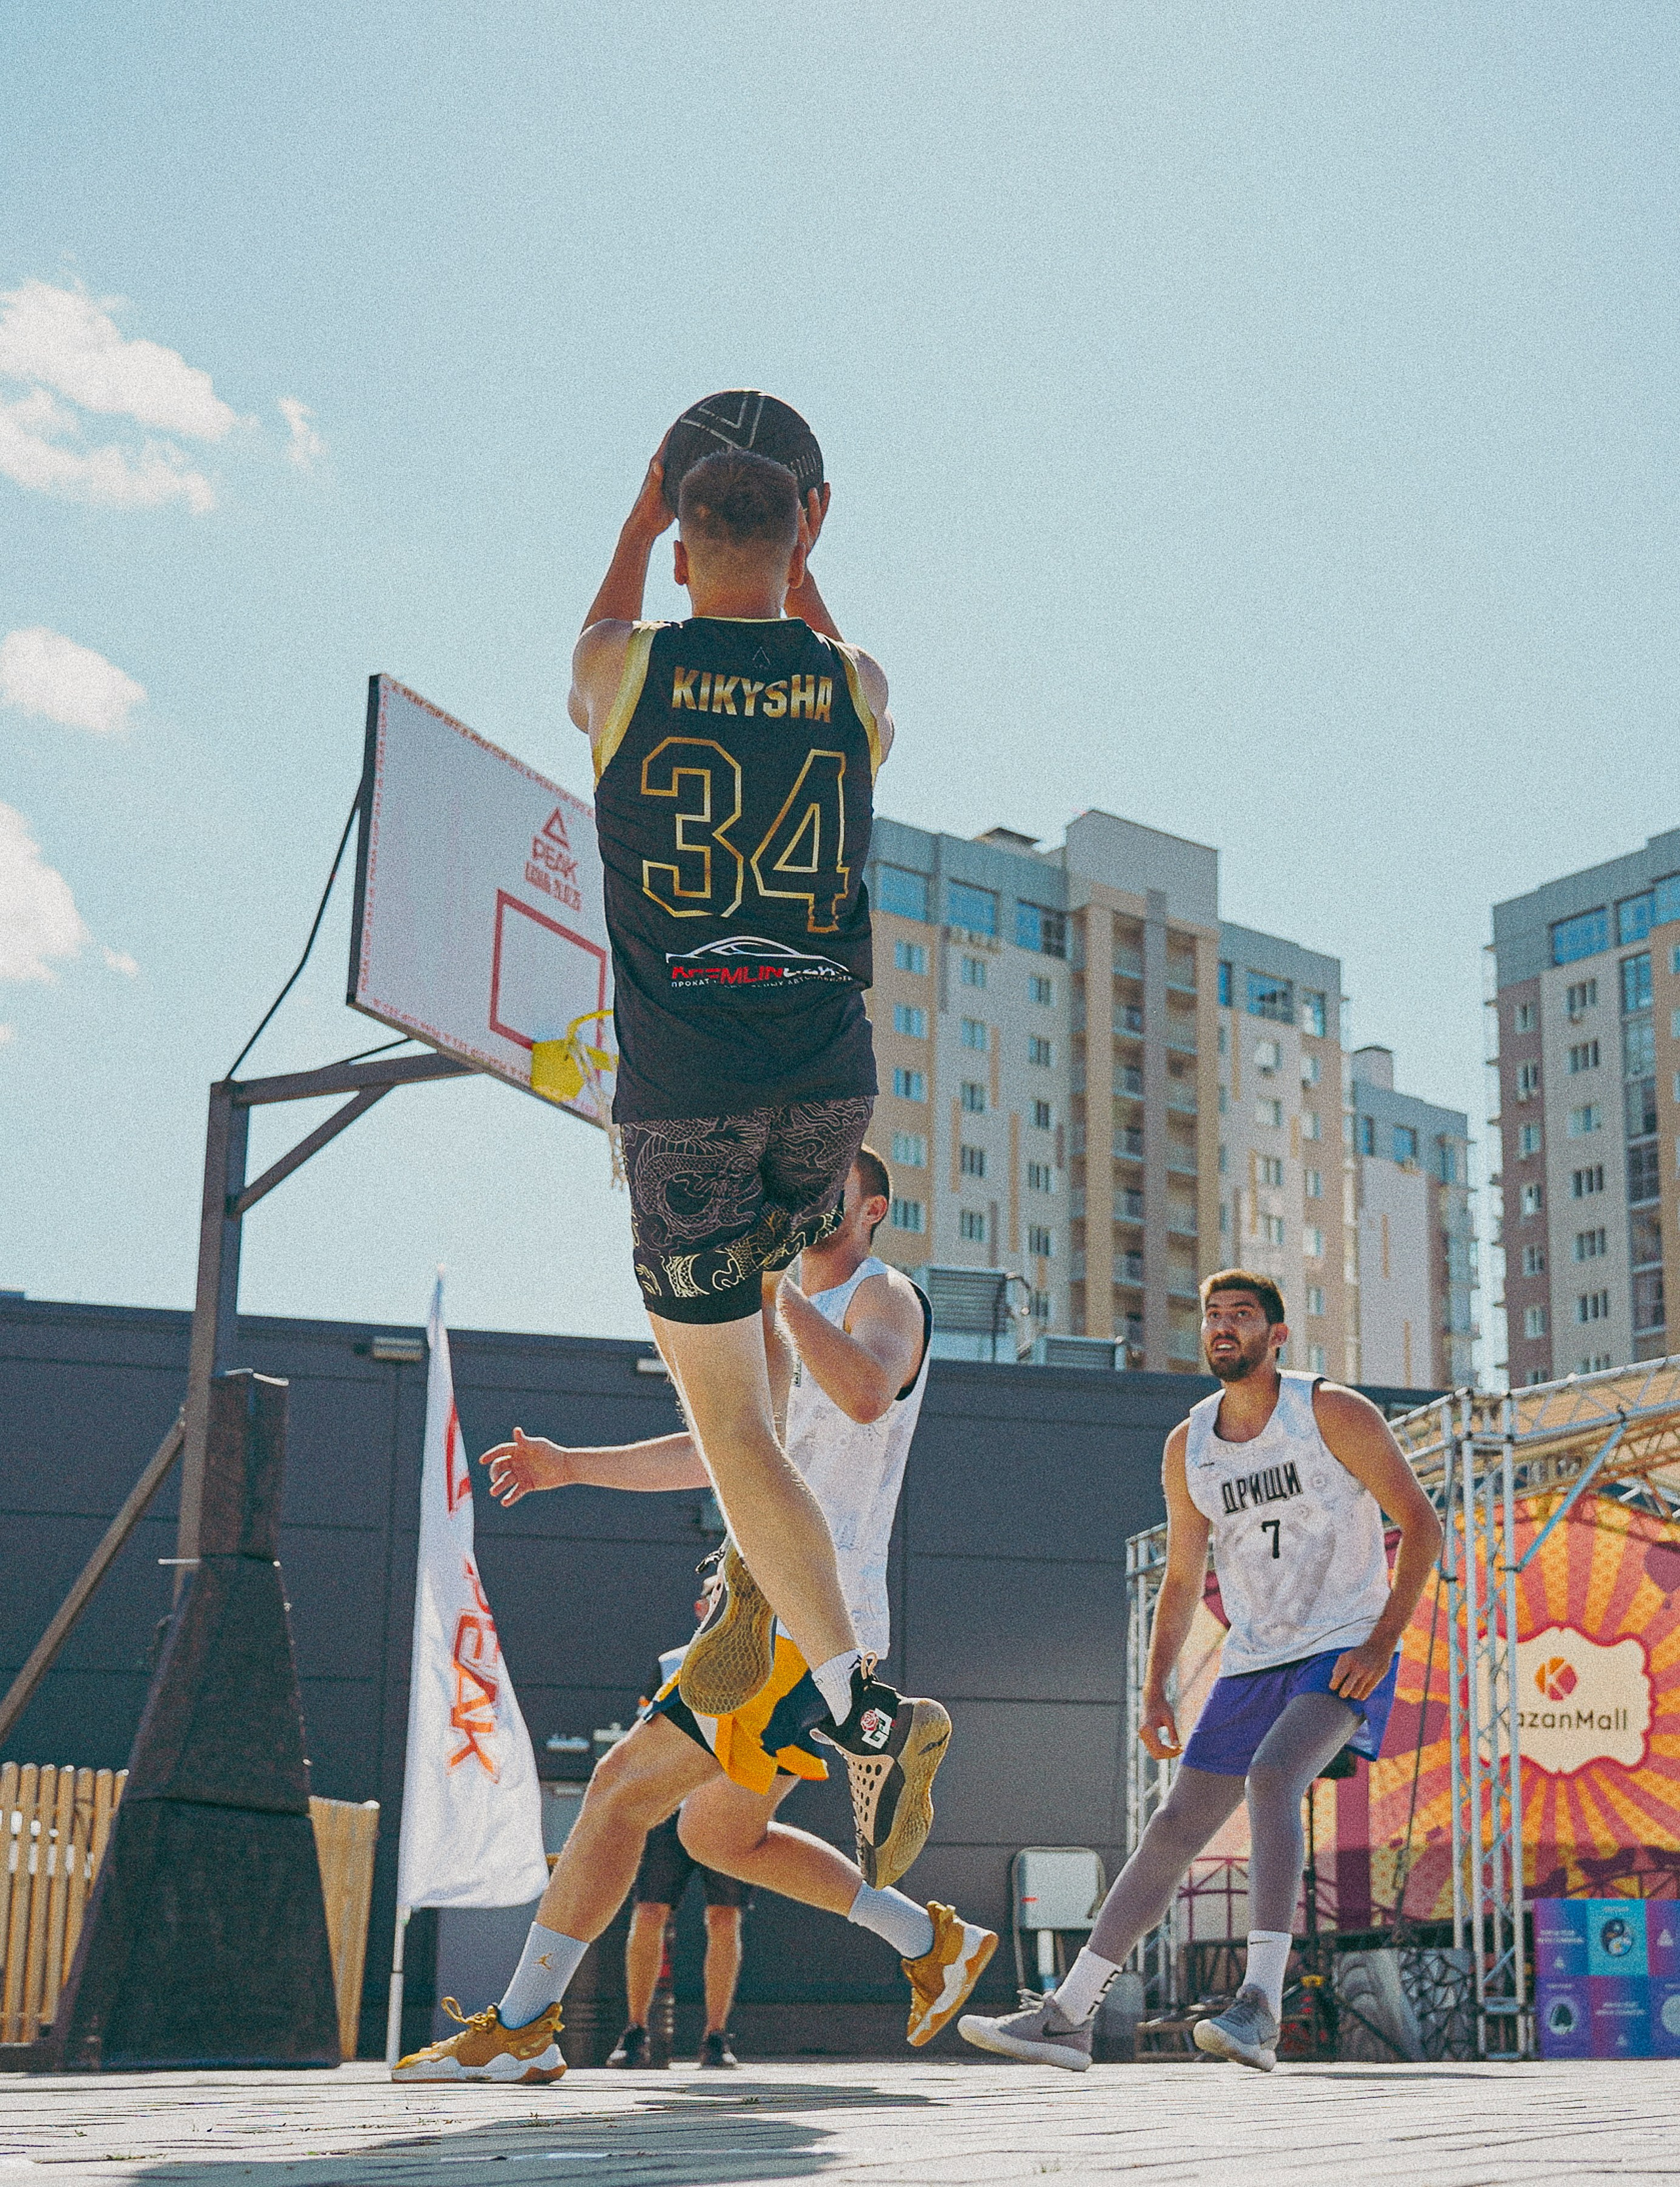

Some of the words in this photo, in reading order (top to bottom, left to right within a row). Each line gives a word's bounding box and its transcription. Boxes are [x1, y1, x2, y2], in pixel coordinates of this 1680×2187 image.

[672, 666, 832, 722] KIKYSHA
[532, 836, 579, 884] PEAK
[641, 736, 849, 933] 34
[1221, 1461, 1303, 1516] ДРИЩИ
[1261, 1518, 1281, 1560] 7
